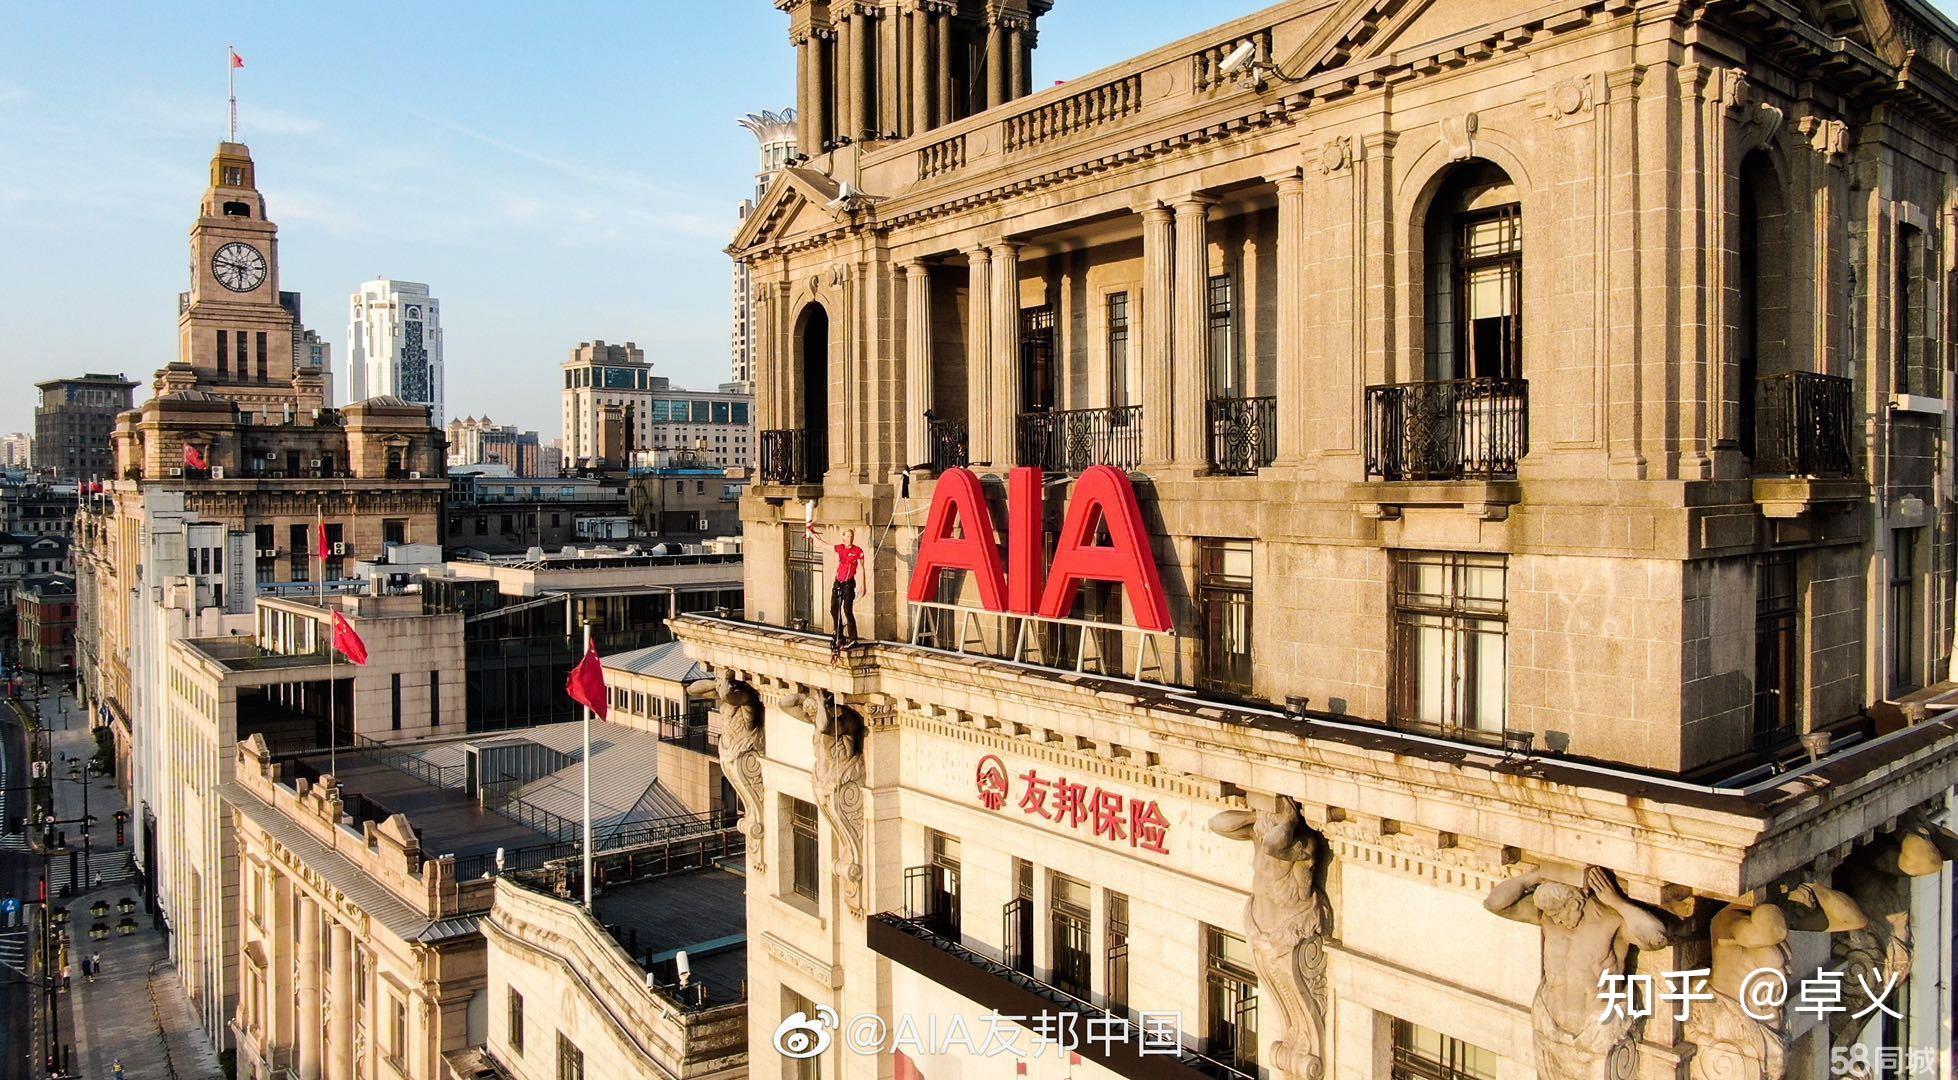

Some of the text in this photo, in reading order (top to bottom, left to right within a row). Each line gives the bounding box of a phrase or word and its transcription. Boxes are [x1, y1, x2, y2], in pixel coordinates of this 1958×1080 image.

[907, 464, 1174, 632] AIA
[1018, 769, 1170, 855] 友邦保险
